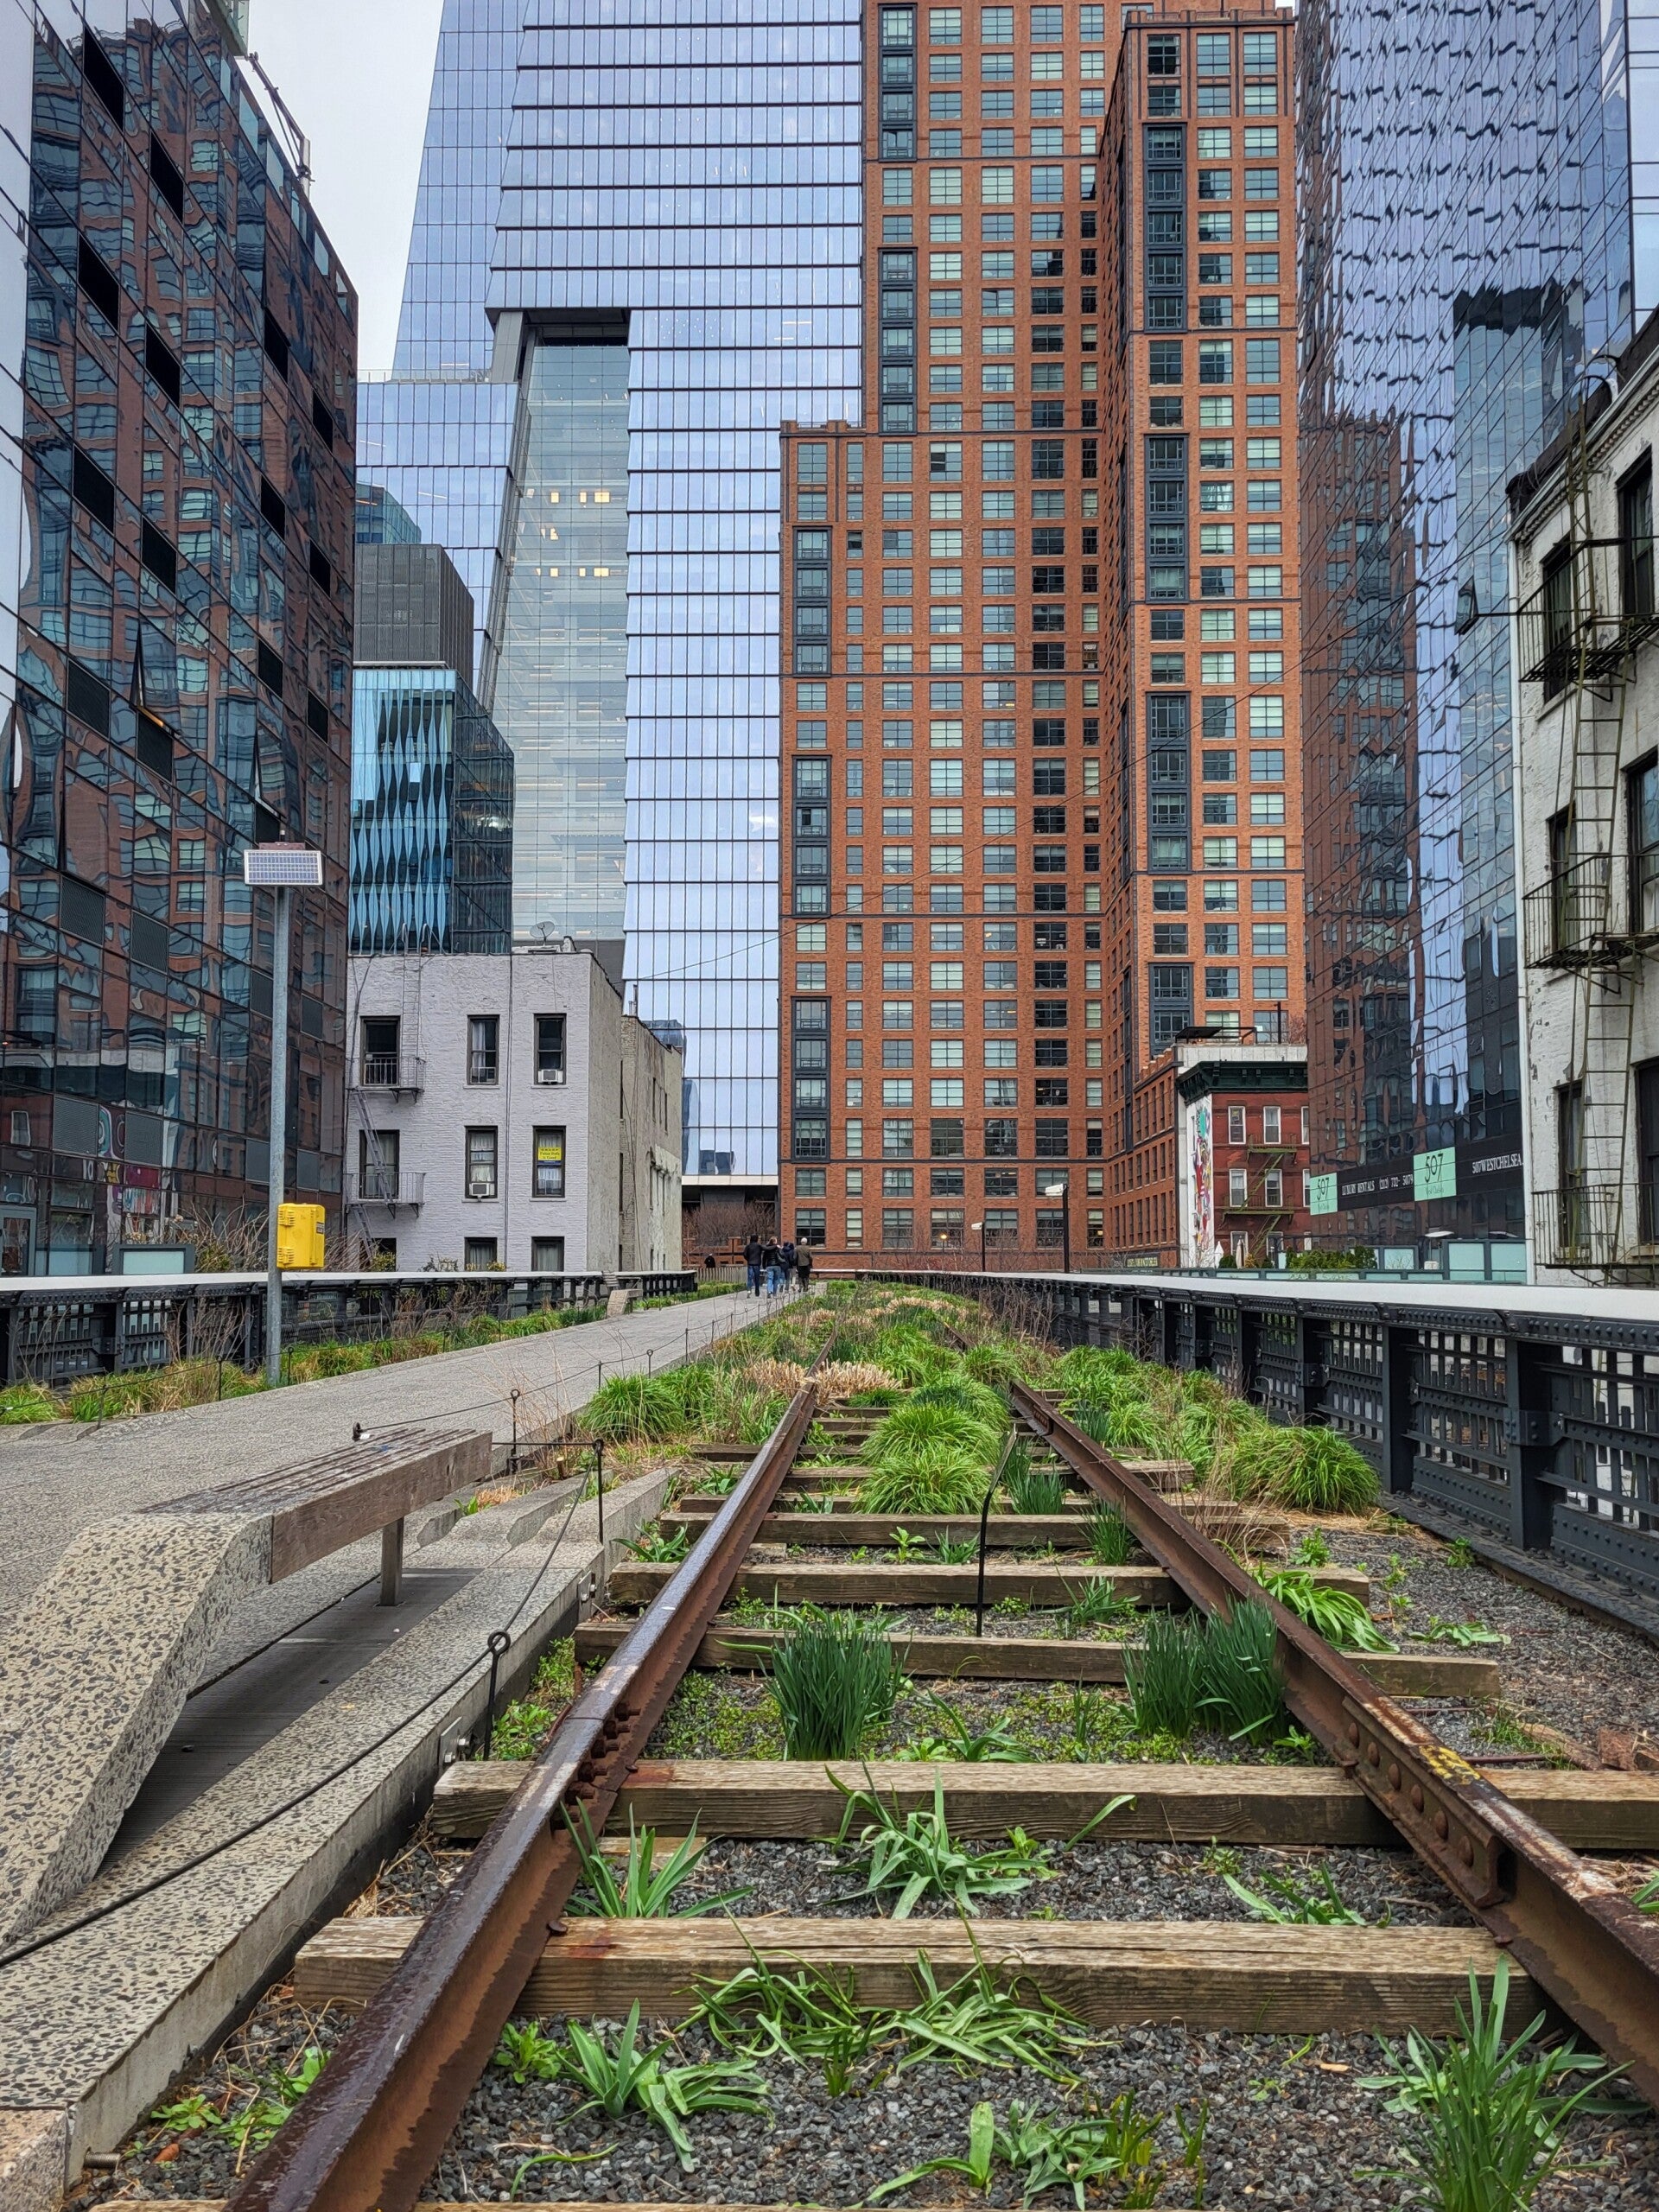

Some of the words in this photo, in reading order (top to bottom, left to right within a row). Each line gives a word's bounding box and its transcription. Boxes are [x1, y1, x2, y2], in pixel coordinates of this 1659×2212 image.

[1425, 1153, 1443, 1183] 507
[1317, 1177, 1329, 1200] 507
[1357, 1180, 1375, 1193] RENTALS
